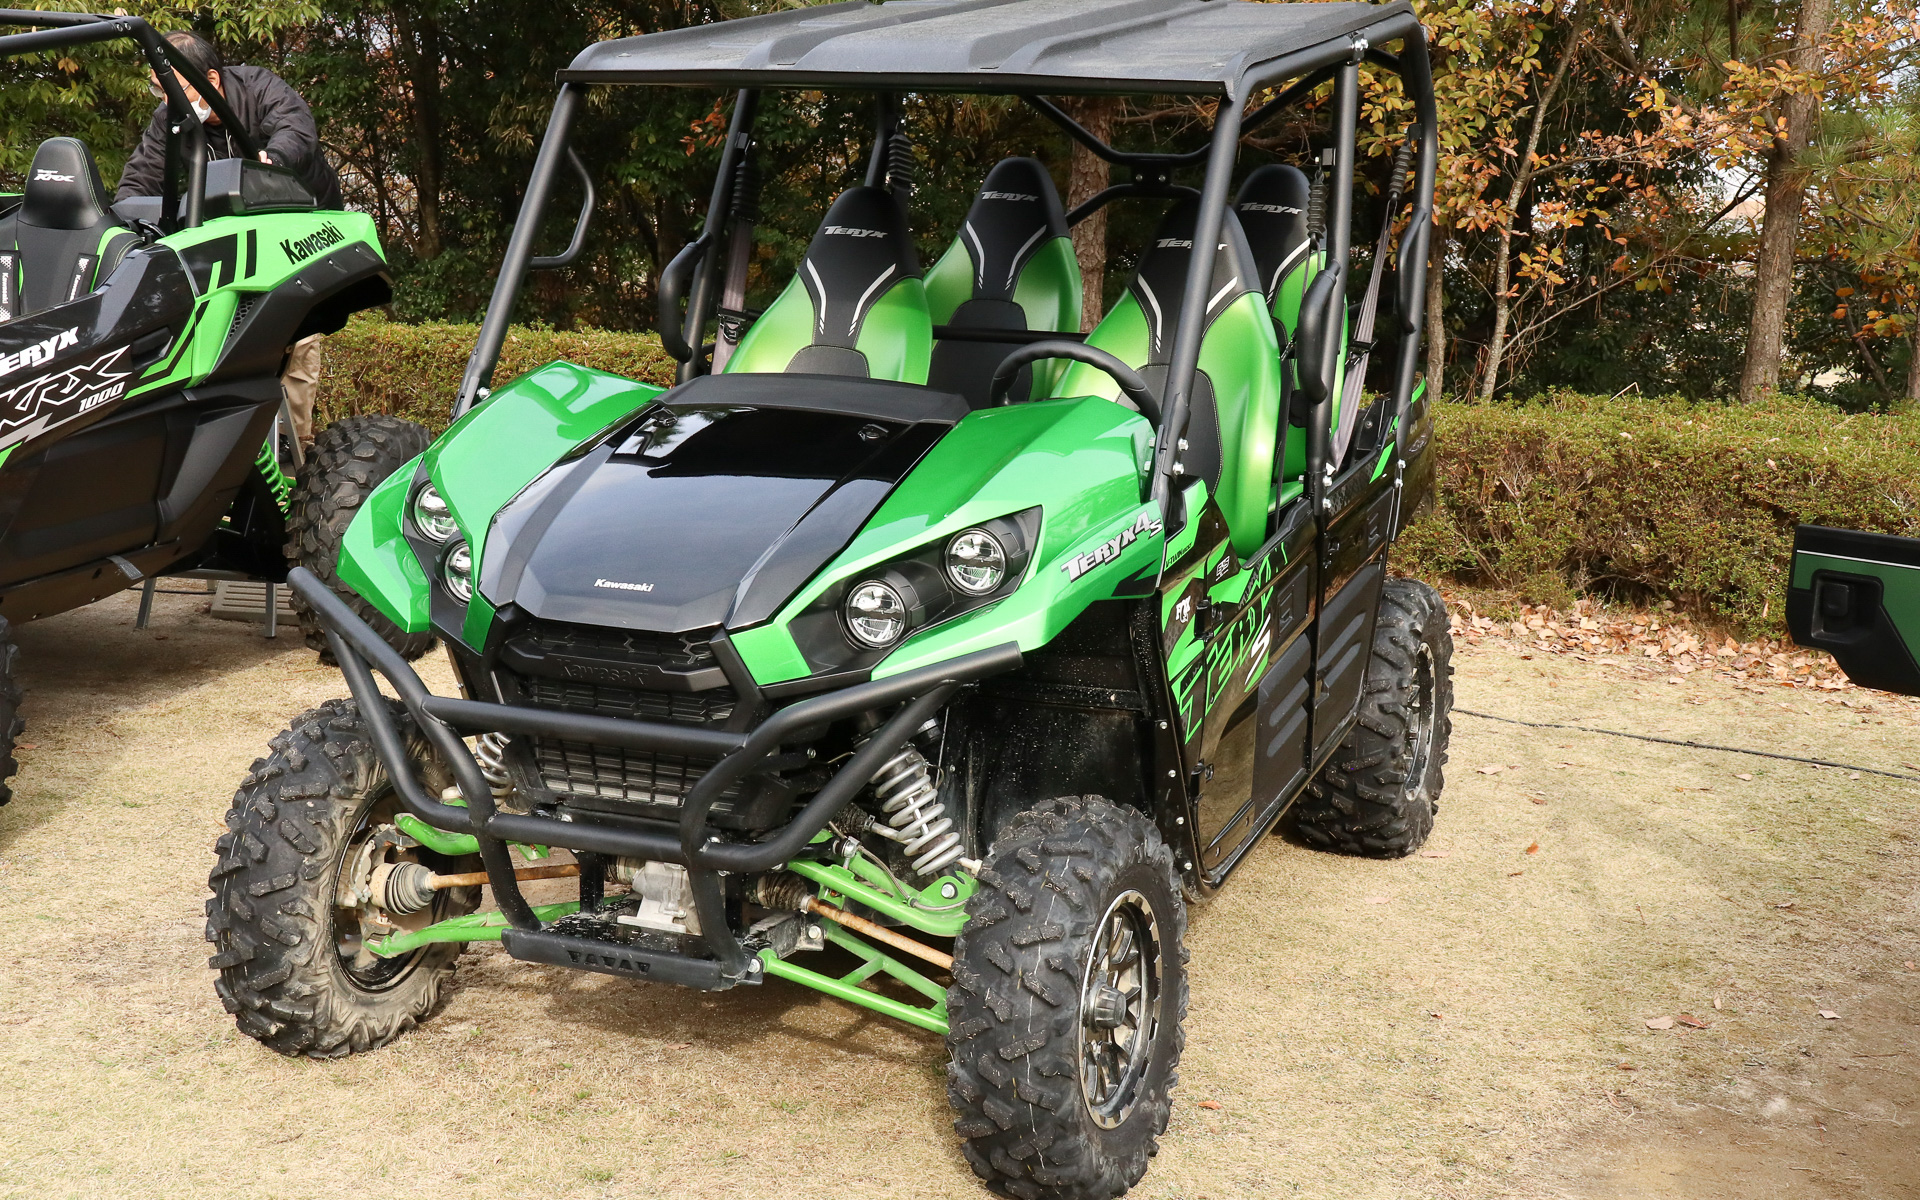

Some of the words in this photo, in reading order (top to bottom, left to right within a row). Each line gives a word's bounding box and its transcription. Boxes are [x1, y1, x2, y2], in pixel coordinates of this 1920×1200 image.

[981, 191, 1039, 202] TERYX
[1240, 202, 1303, 215] TERYX
[824, 225, 888, 239] TERYX
[279, 220, 346, 265] Kawasaki
[1156, 237, 1228, 251] TER
[79, 381, 125, 413] 1000
[593, 578, 654, 592] Kawasaki
[556, 658, 651, 686] Kawasaki
